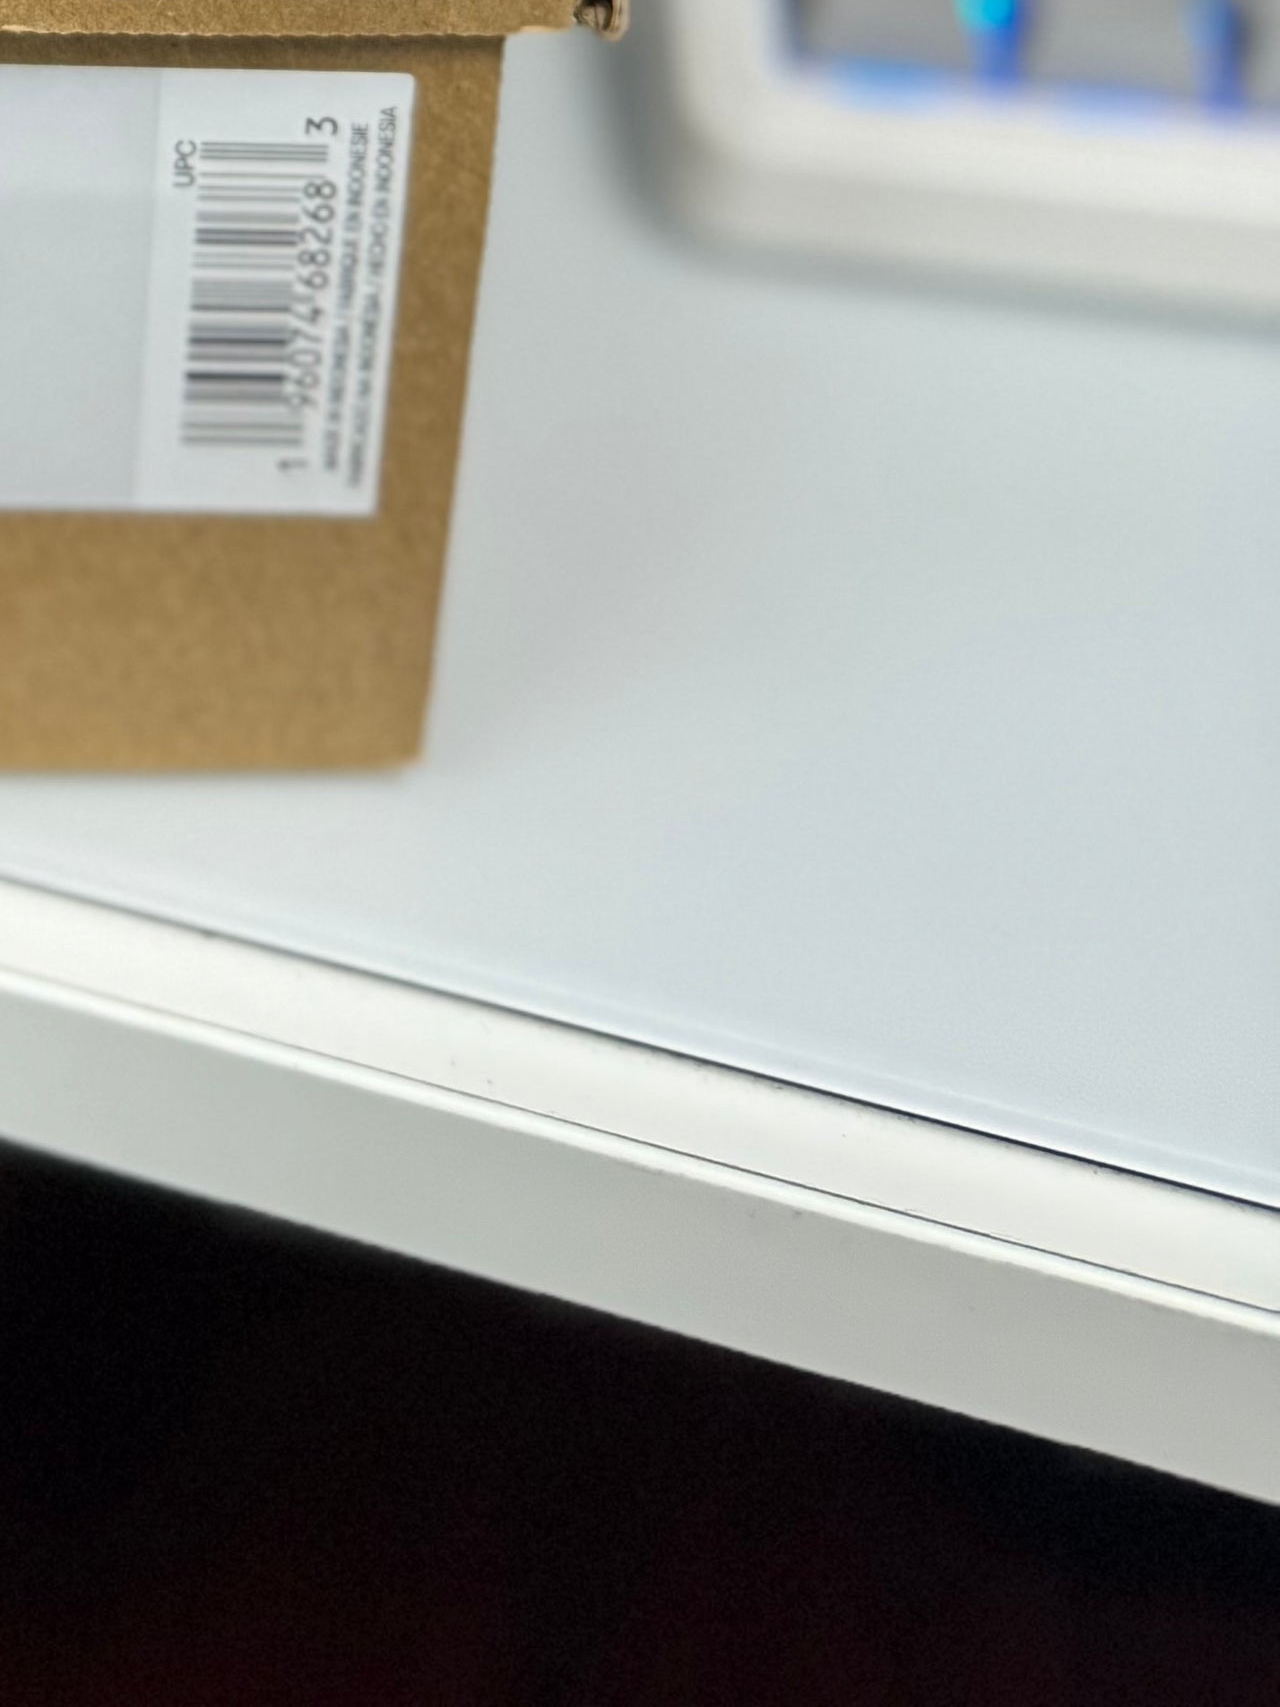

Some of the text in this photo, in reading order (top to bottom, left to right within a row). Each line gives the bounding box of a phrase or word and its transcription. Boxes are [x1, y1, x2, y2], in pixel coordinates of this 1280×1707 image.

[304, 115, 340, 137] 3
[172, 138, 198, 189] UPC
[298, 178, 338, 289] 68268
